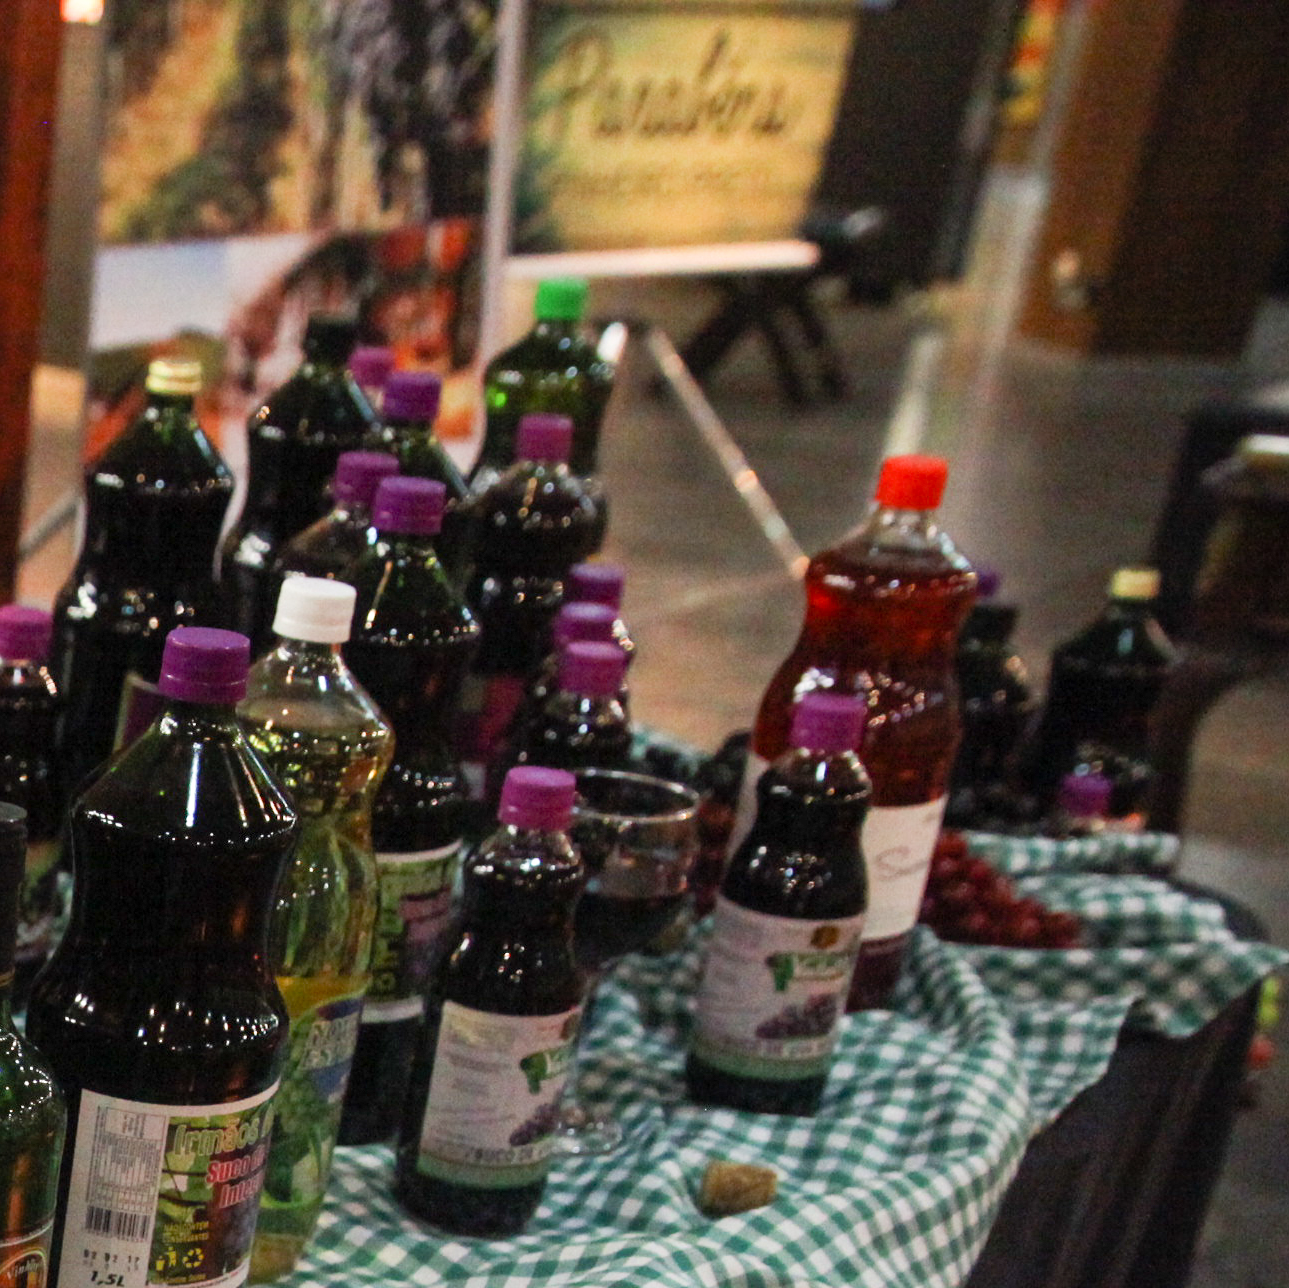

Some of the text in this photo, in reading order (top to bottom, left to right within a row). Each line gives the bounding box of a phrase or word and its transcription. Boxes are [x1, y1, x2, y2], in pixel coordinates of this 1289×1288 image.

[175, 1117, 260, 1156] Irmãos
[207, 1156, 248, 1184] Suco
[90, 1270, 125, 1288] 1,5L
